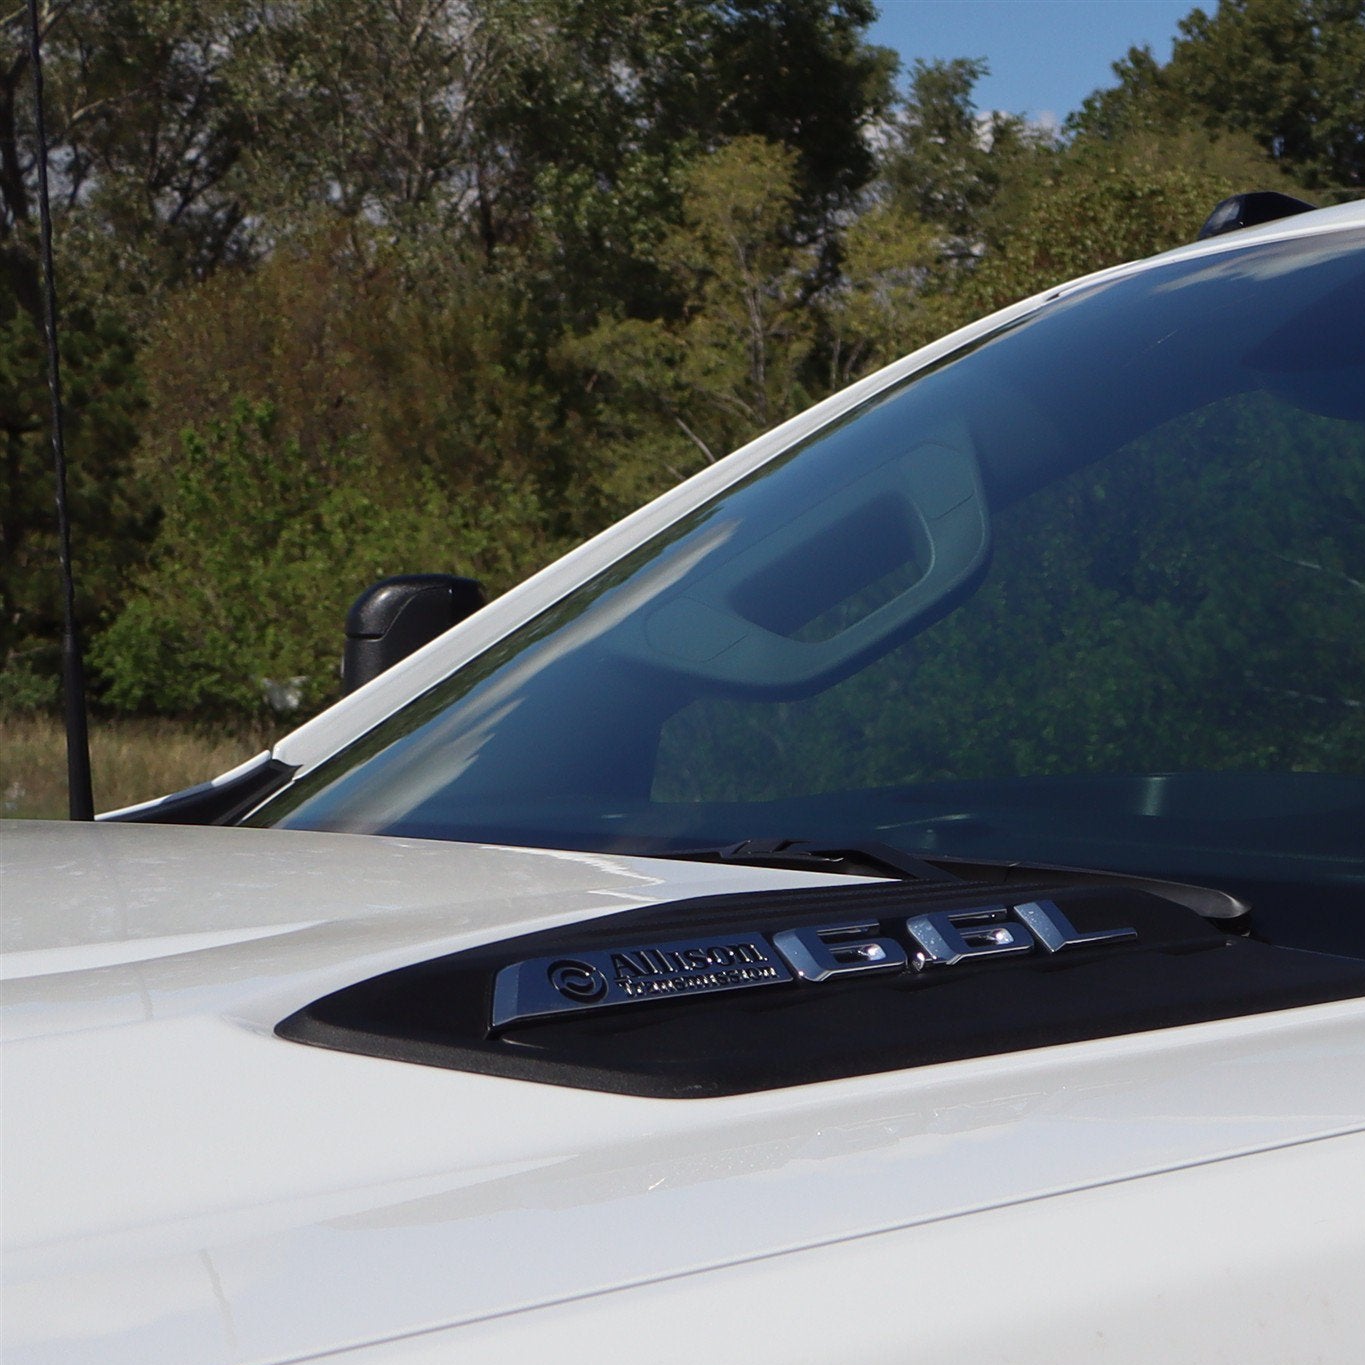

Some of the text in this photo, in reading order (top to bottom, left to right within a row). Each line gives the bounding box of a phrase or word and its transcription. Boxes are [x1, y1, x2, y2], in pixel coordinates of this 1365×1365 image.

[772, 899, 1138, 982] 6.6L
[609, 942, 769, 980] Allison
[614, 966, 780, 997] Transmission
